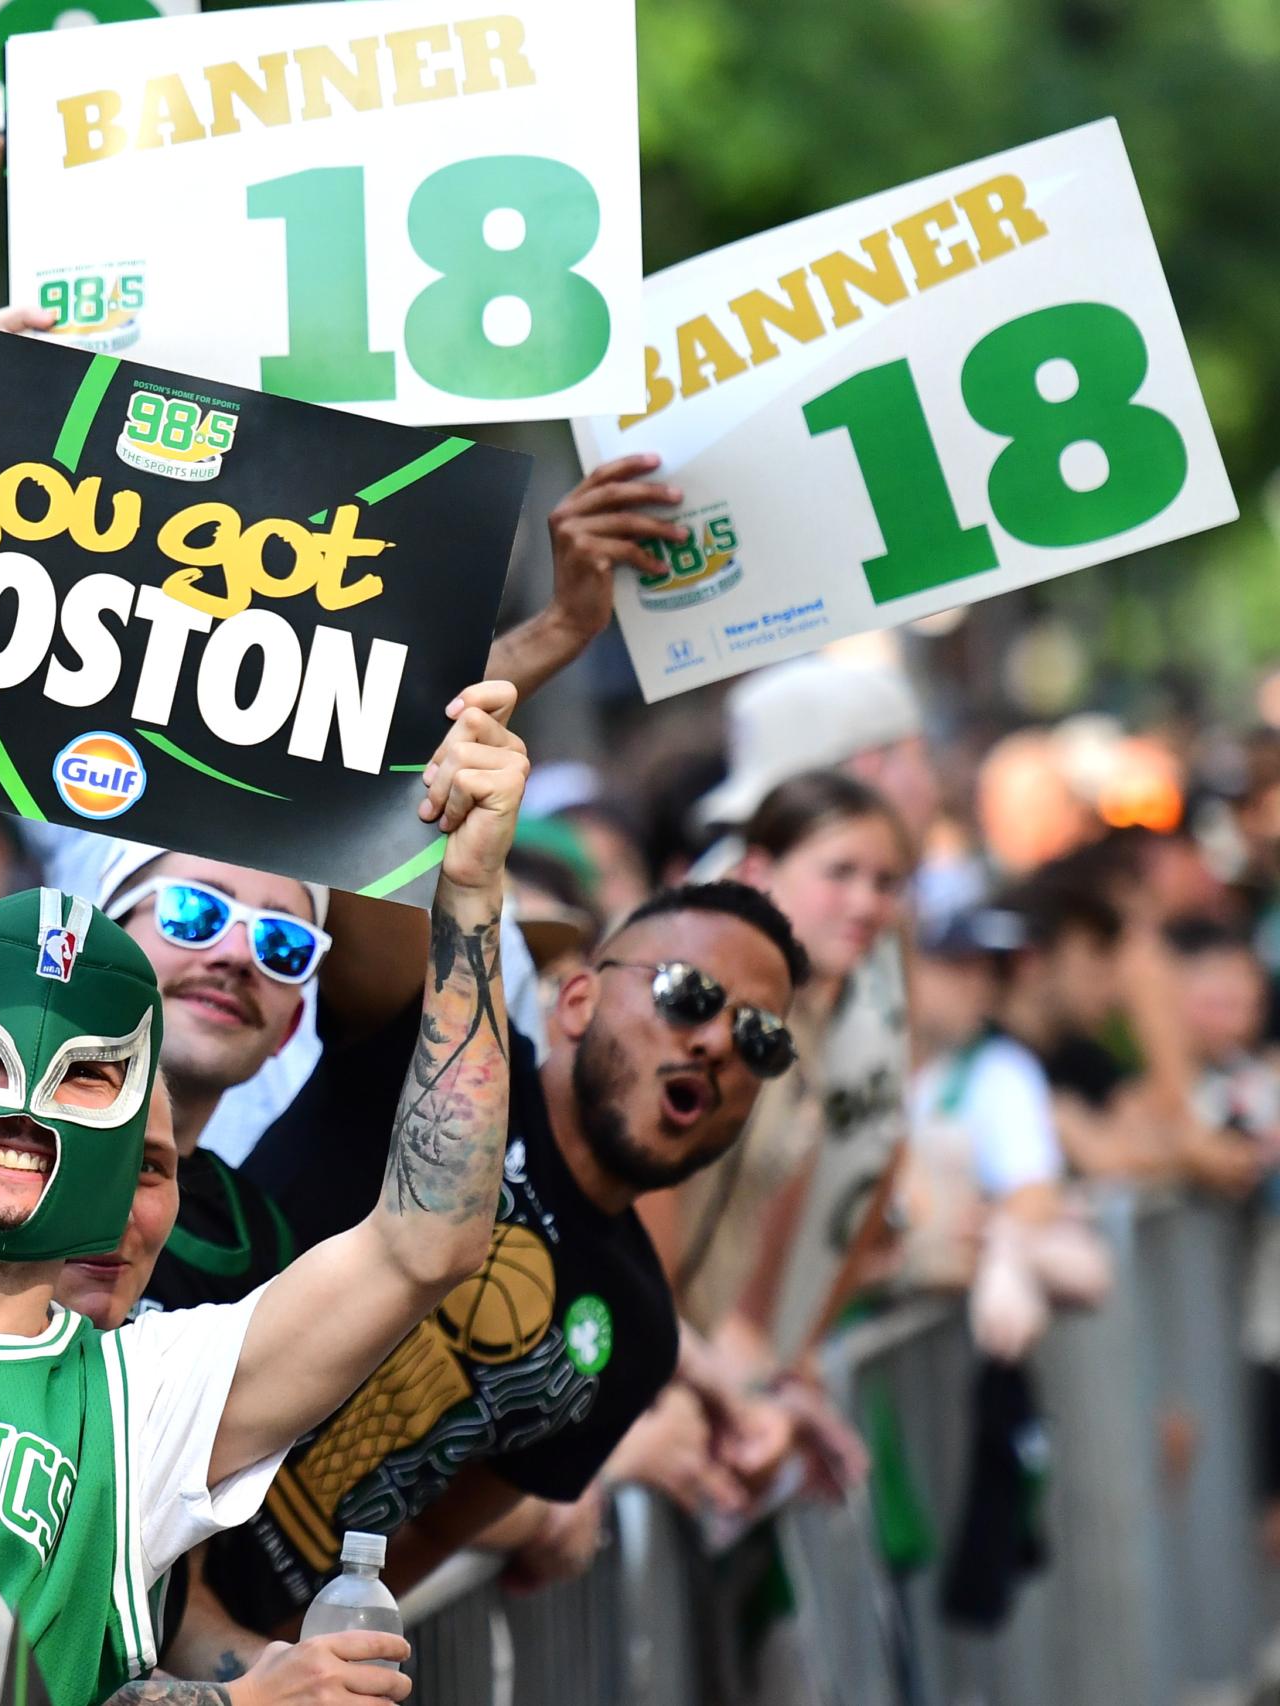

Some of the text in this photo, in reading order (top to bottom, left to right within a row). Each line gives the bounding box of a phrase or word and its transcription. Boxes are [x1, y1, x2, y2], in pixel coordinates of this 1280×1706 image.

[56, 13, 537, 169] BANNER
[39, 274, 145, 327] 98.5
[245, 154, 612, 404] 18
[125, 392, 236, 452] 98.5
[133, 379, 241, 411] BOSTON'S HOME FOR SPORTS
[122, 447, 216, 478] THE SPORTS HUB
[801, 301, 1189, 606] 18
[156, 501, 396, 619] got
[724, 598, 824, 636] New England
[61, 757, 138, 794] Gulf
